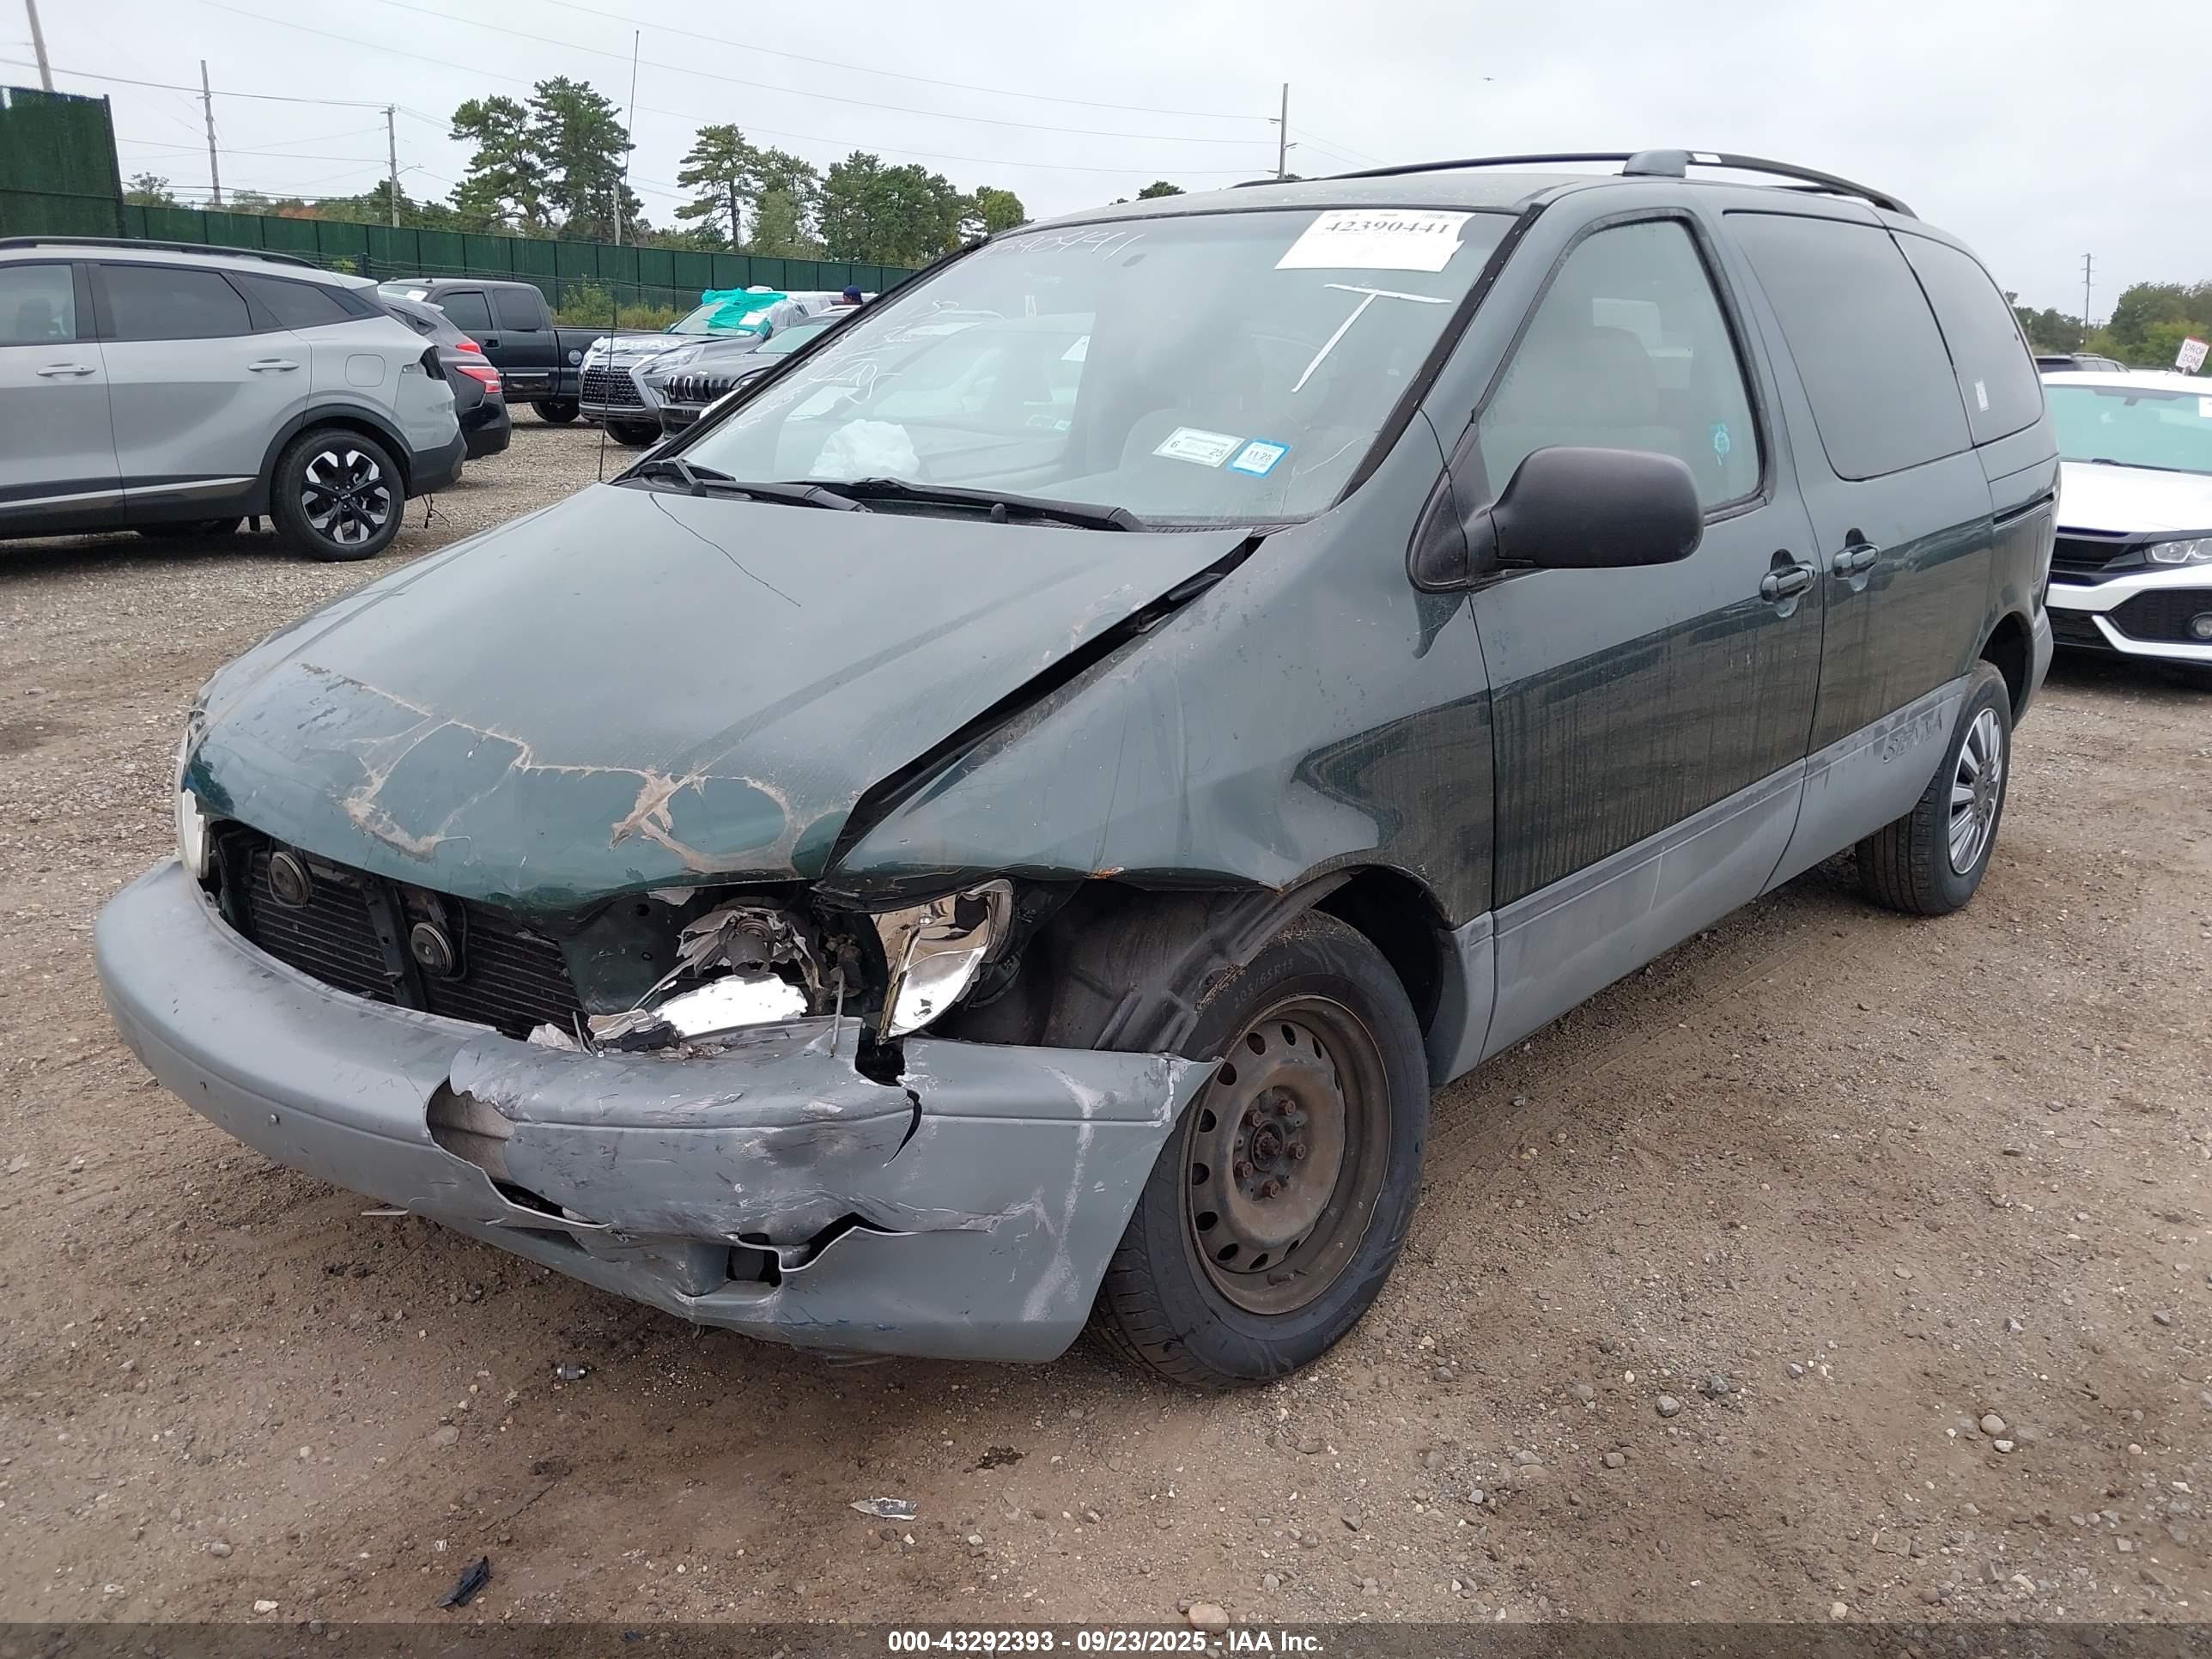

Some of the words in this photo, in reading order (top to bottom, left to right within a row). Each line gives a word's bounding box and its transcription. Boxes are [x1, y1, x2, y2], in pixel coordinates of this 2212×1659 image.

[1325, 220, 1451, 234] 42390441
[2185, 343, 2205, 355] DROP
[2183, 353, 2201, 367] ZONE
[1208, 447, 1224, 458] 25
